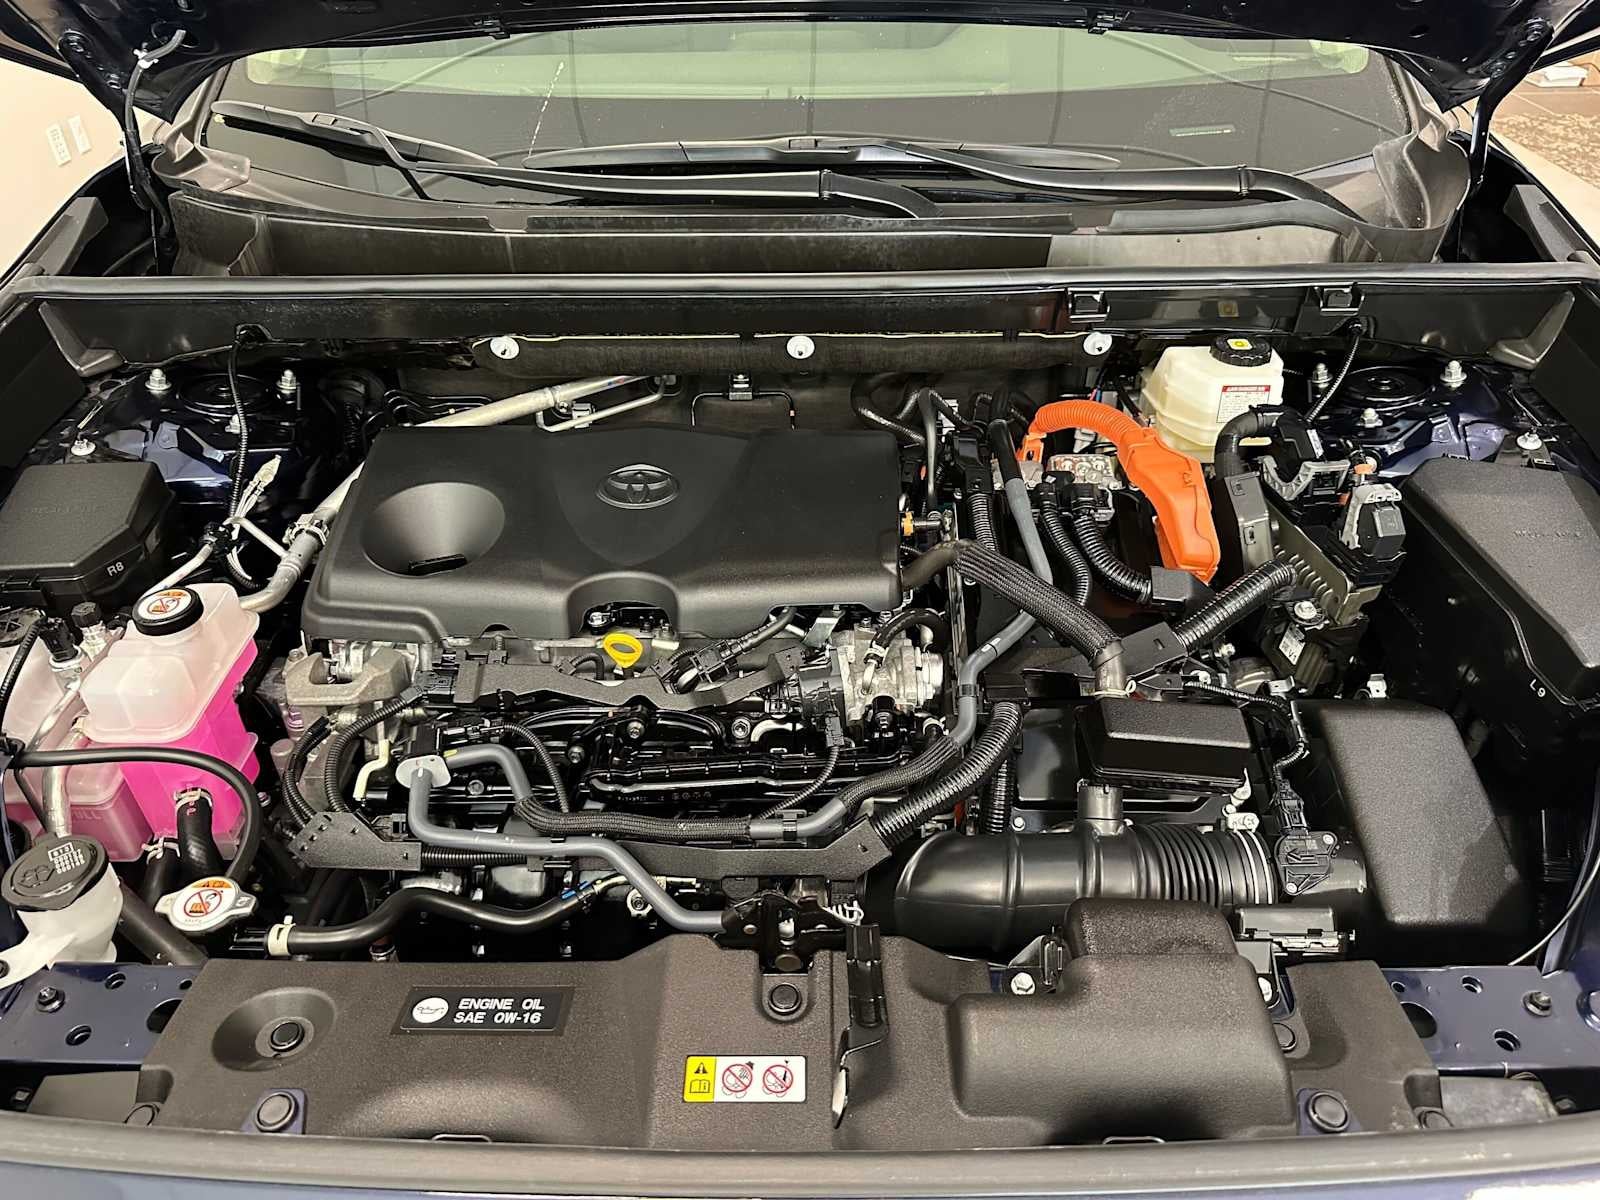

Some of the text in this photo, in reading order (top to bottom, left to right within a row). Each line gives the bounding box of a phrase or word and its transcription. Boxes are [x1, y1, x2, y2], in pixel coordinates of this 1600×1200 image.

[106, 561, 125, 577] R8
[457, 998, 545, 1010] ENGINE OIL
[453, 1011, 542, 1024] SAE 0W-16
